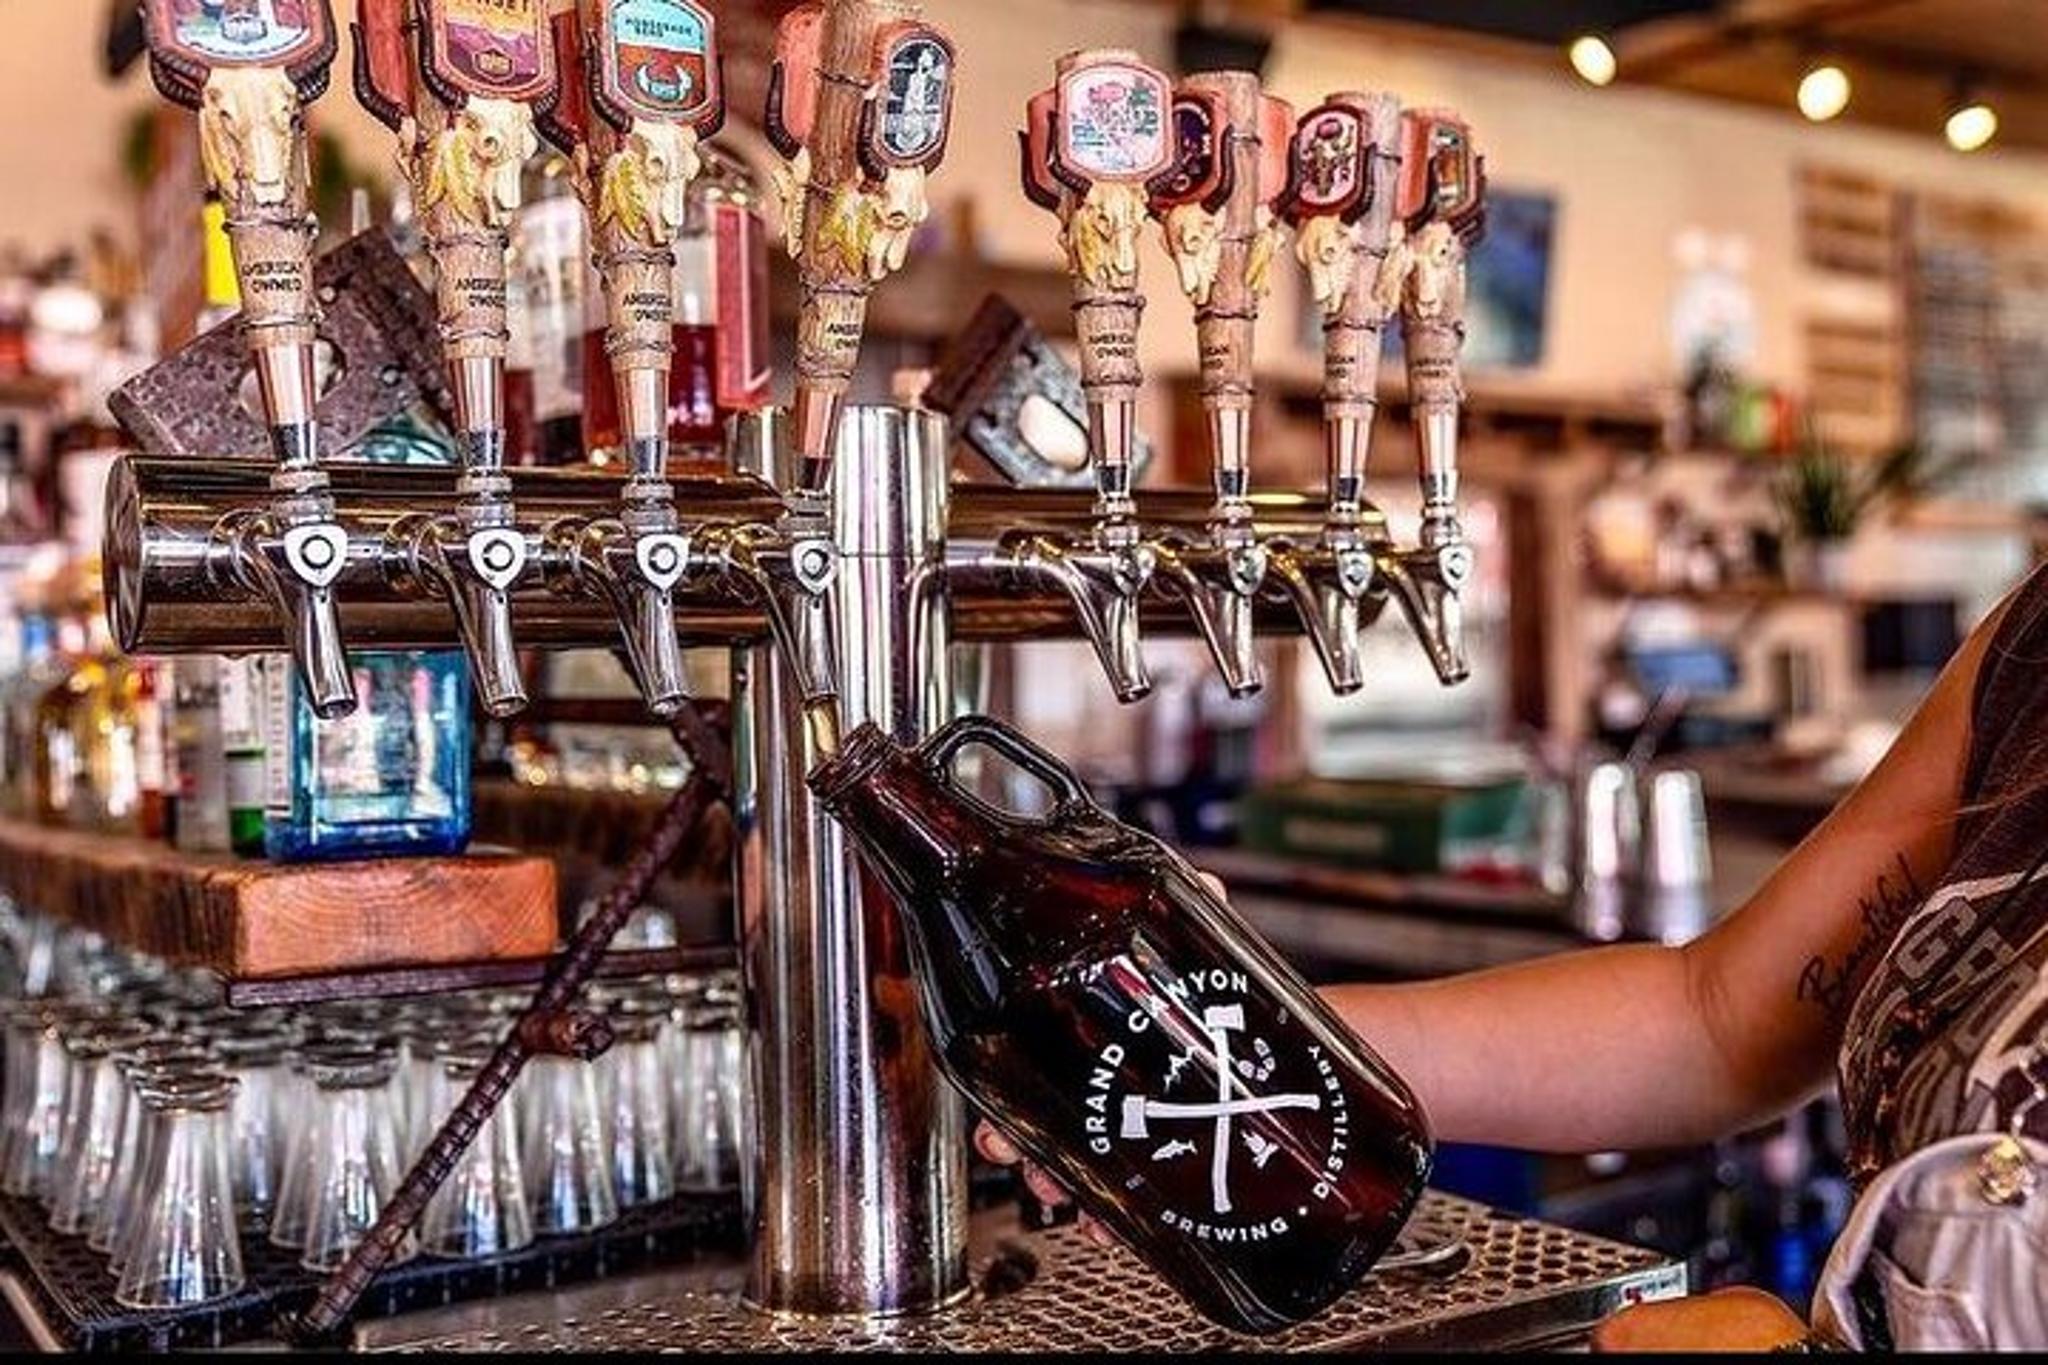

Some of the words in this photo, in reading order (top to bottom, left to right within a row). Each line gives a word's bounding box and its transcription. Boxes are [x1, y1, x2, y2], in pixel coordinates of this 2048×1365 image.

[1085, 1043, 1126, 1155] GRAND
[1127, 968, 1249, 1034] CANYON
[1307, 1044, 1349, 1200] DISTILLERY
[1159, 1208, 1290, 1243] BREWING
